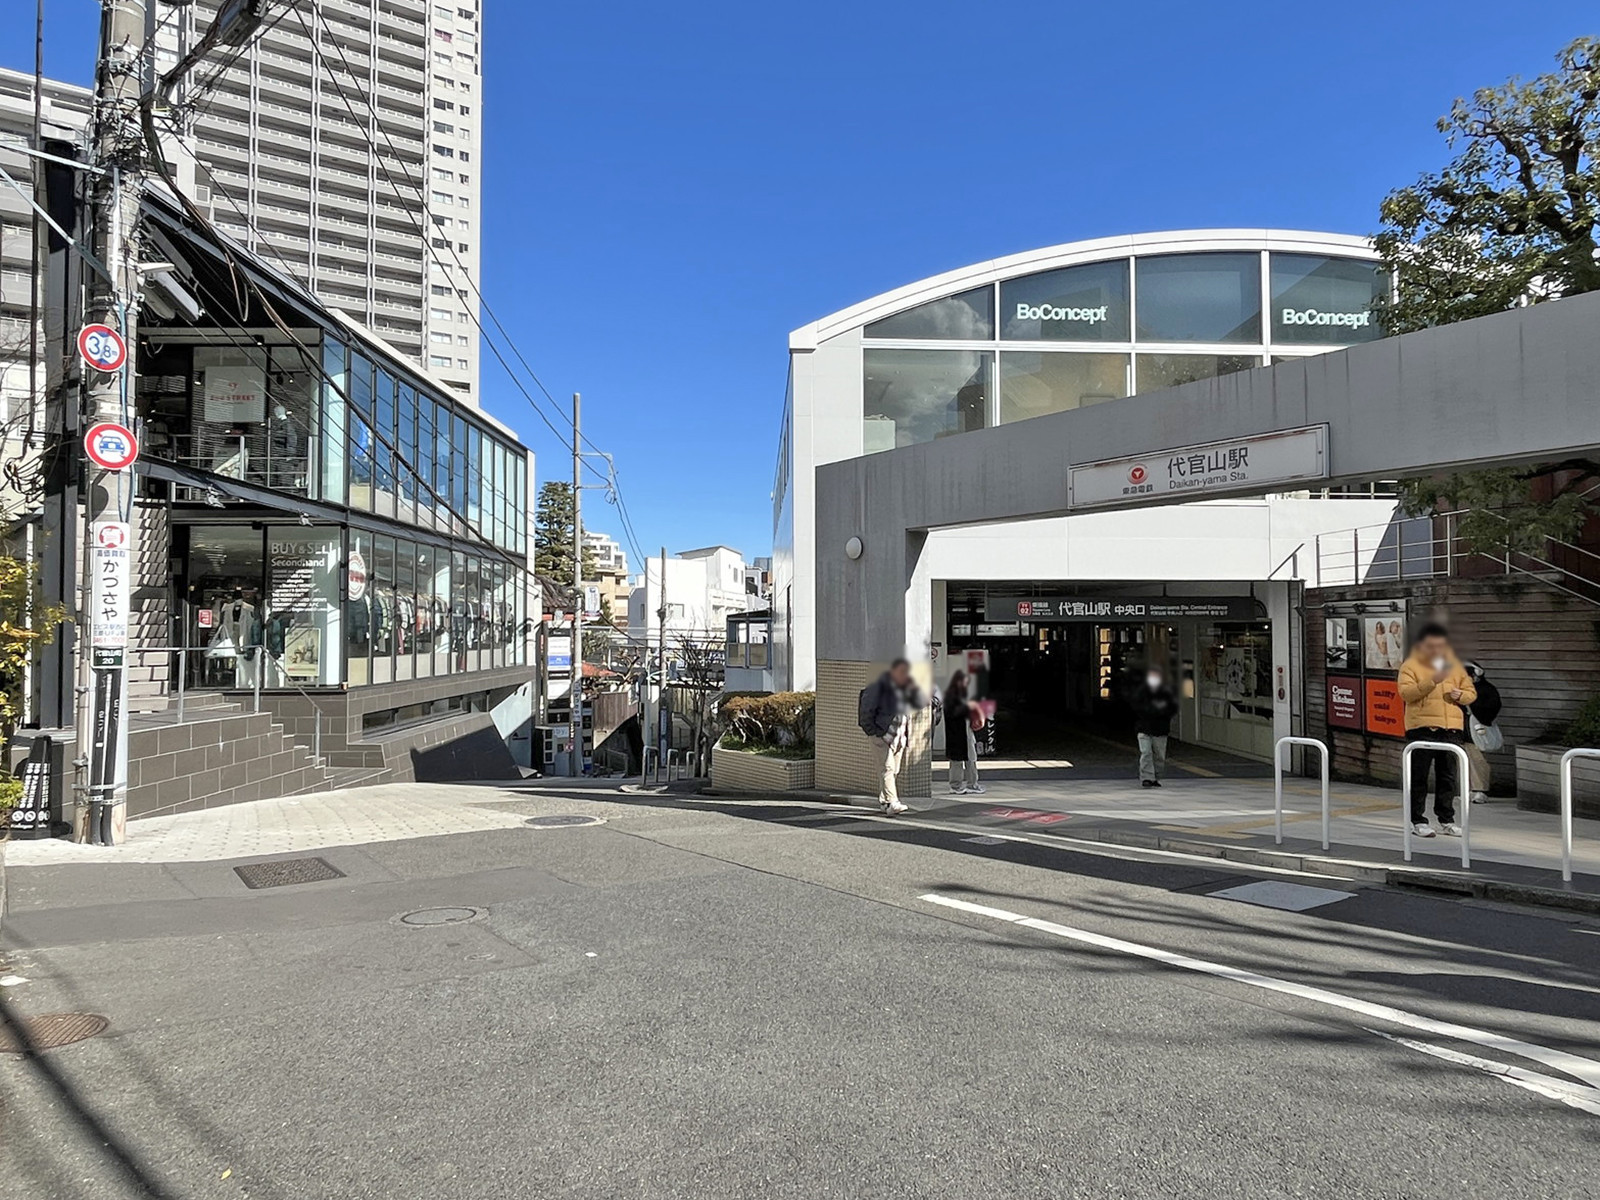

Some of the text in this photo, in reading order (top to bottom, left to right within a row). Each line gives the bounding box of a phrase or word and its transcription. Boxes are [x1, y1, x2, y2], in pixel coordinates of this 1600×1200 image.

[1016, 303, 1108, 325] BoConcept
[1282, 308, 1371, 330] BoConcept
[1167, 446, 1249, 478] 代官山駅
[1168, 472, 1249, 490] Daikan-yama Sta.
[271, 542, 297, 555] BUY
[299, 545, 307, 555] &
[271, 557, 326, 567] Secondhand
[1059, 602, 1146, 616] 代官山駅 中央口
